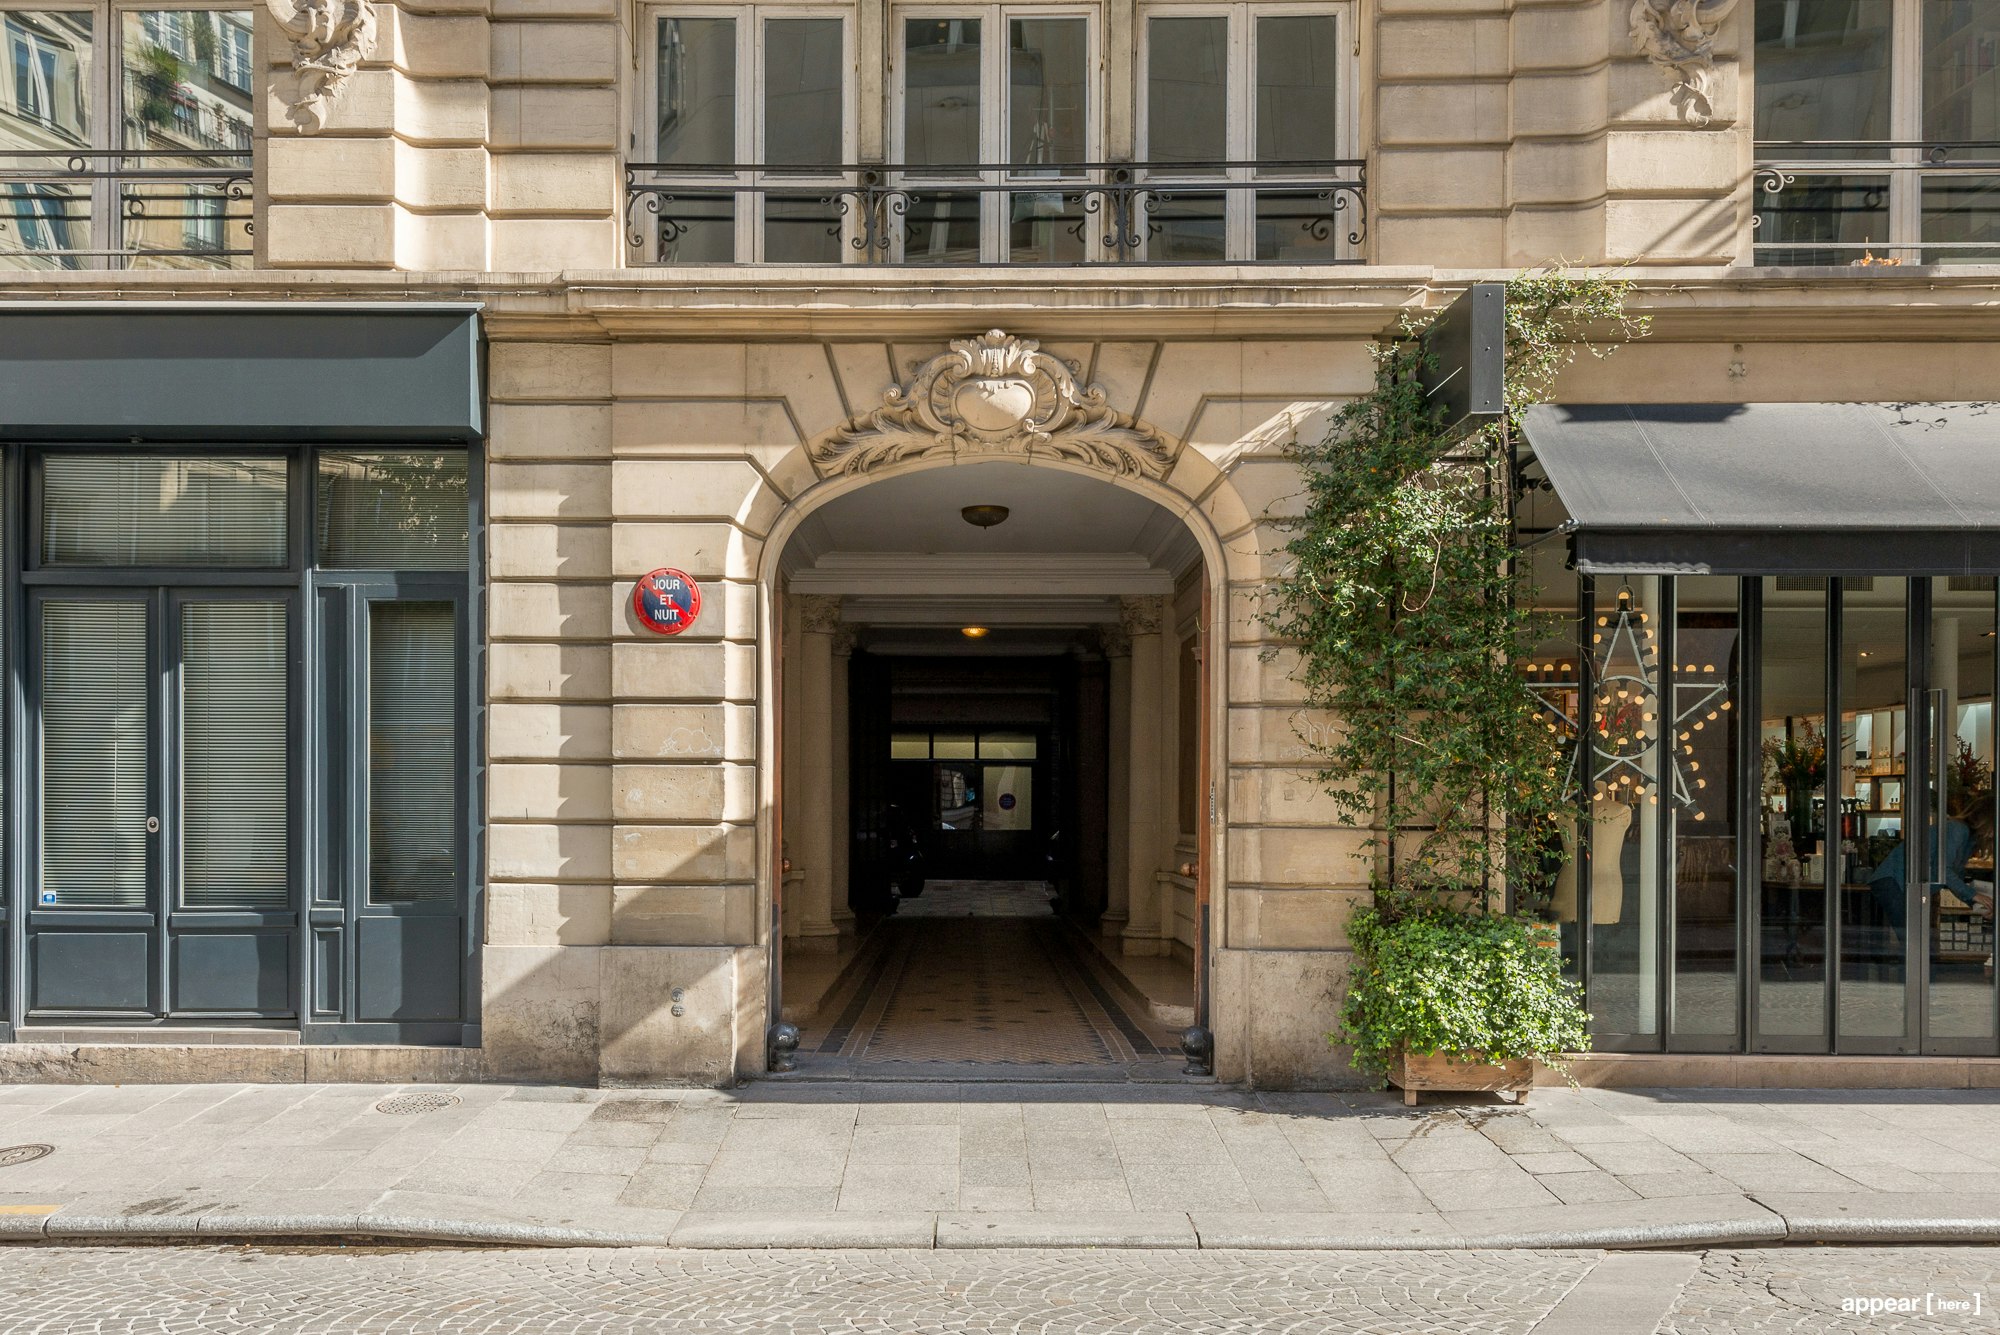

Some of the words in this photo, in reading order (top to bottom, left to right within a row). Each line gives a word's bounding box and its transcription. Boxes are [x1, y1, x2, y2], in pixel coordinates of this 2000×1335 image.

[652, 579, 680, 590] JOUR
[659, 594, 673, 605] ET
[654, 609, 679, 620] NUIT
